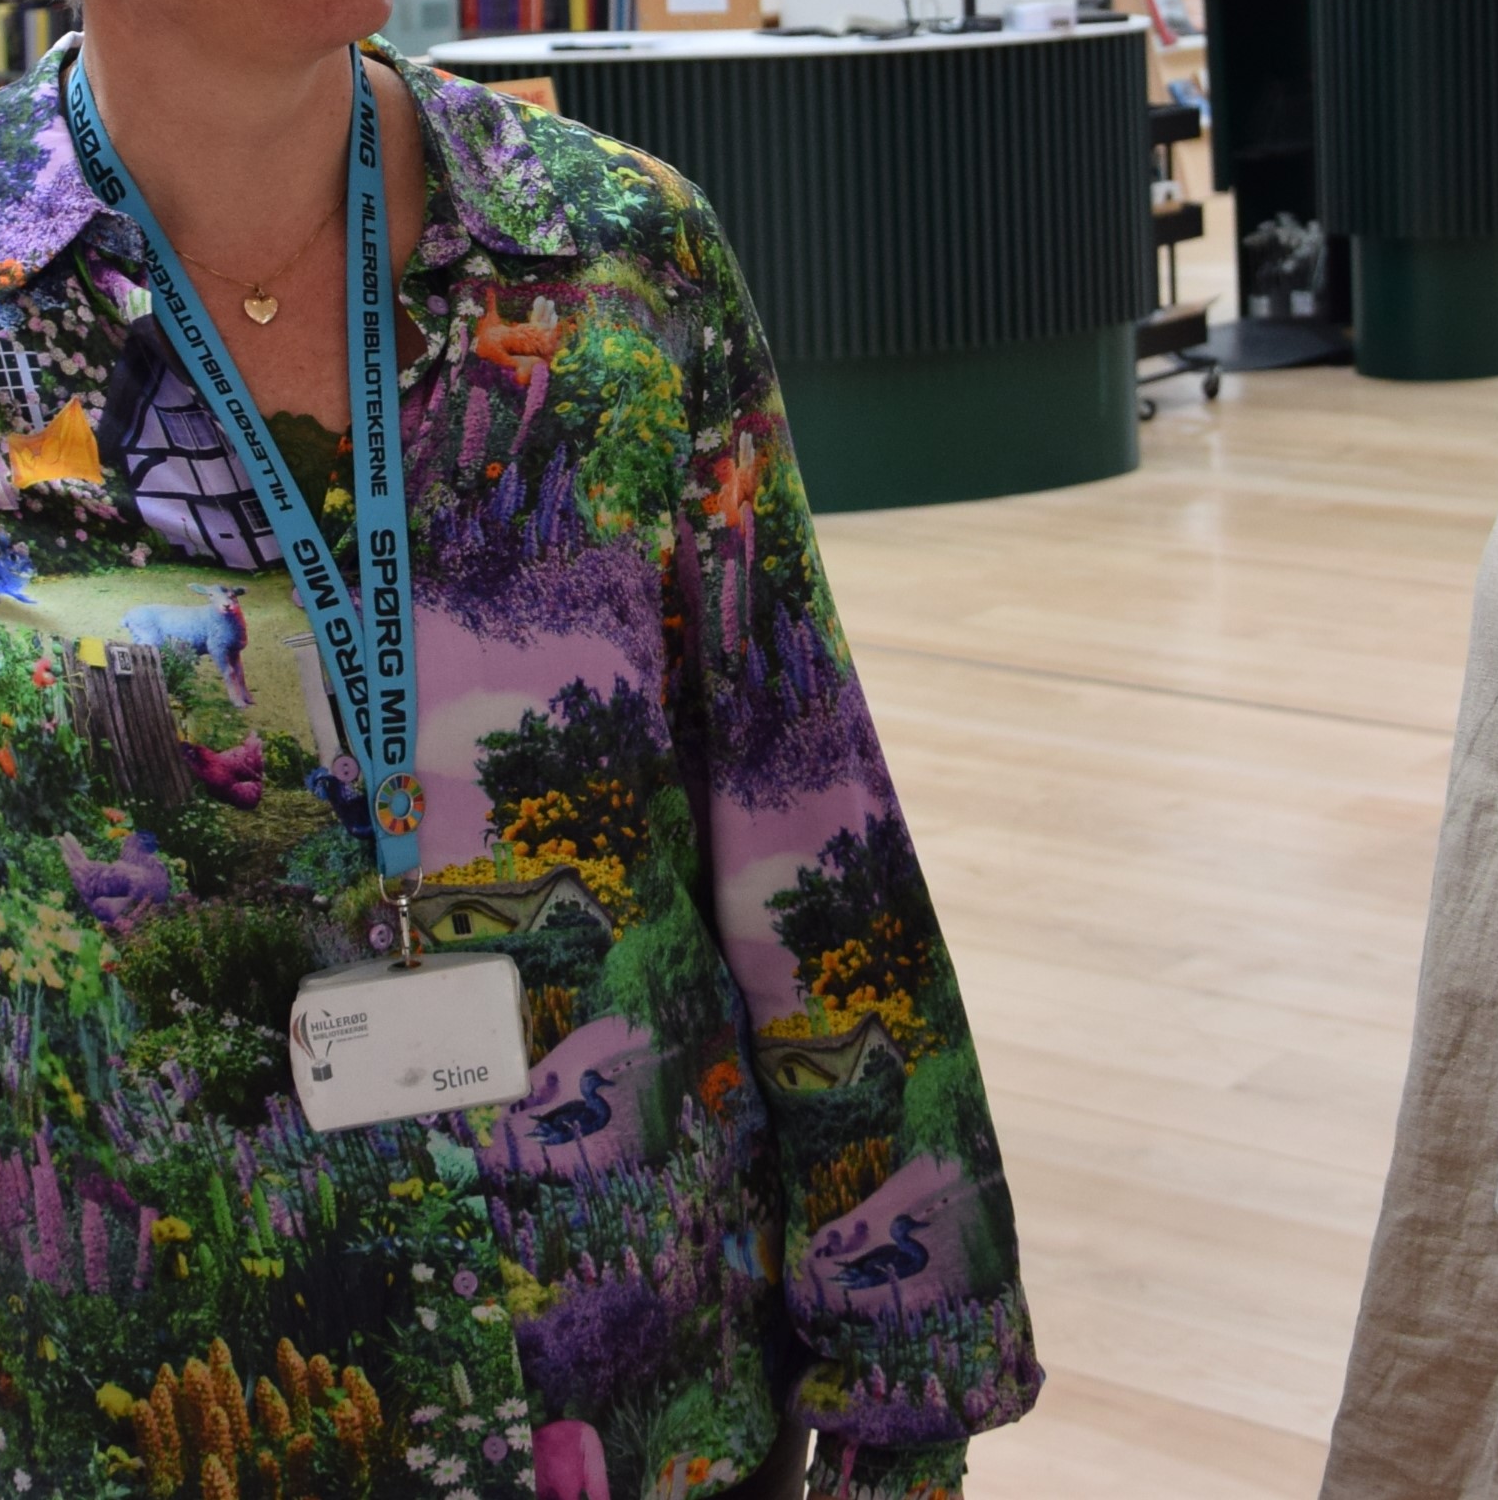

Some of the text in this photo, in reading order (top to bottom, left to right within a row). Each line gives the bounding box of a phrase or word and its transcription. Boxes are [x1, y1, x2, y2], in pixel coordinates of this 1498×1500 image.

[359, 101, 376, 169] MIG
[362, 192, 388, 499] HILLERØD BIBLIOTEKERNE
[225, 397, 294, 512] HILLERØD
[292, 538, 341, 611] MIG
[370, 528, 407, 766] SPØRG MIG
[310, 1012, 368, 1033] HILLERØD
[312, 1024, 369, 1041] BIBLIOTEKERNE
[432, 1065, 490, 1092] Stine
